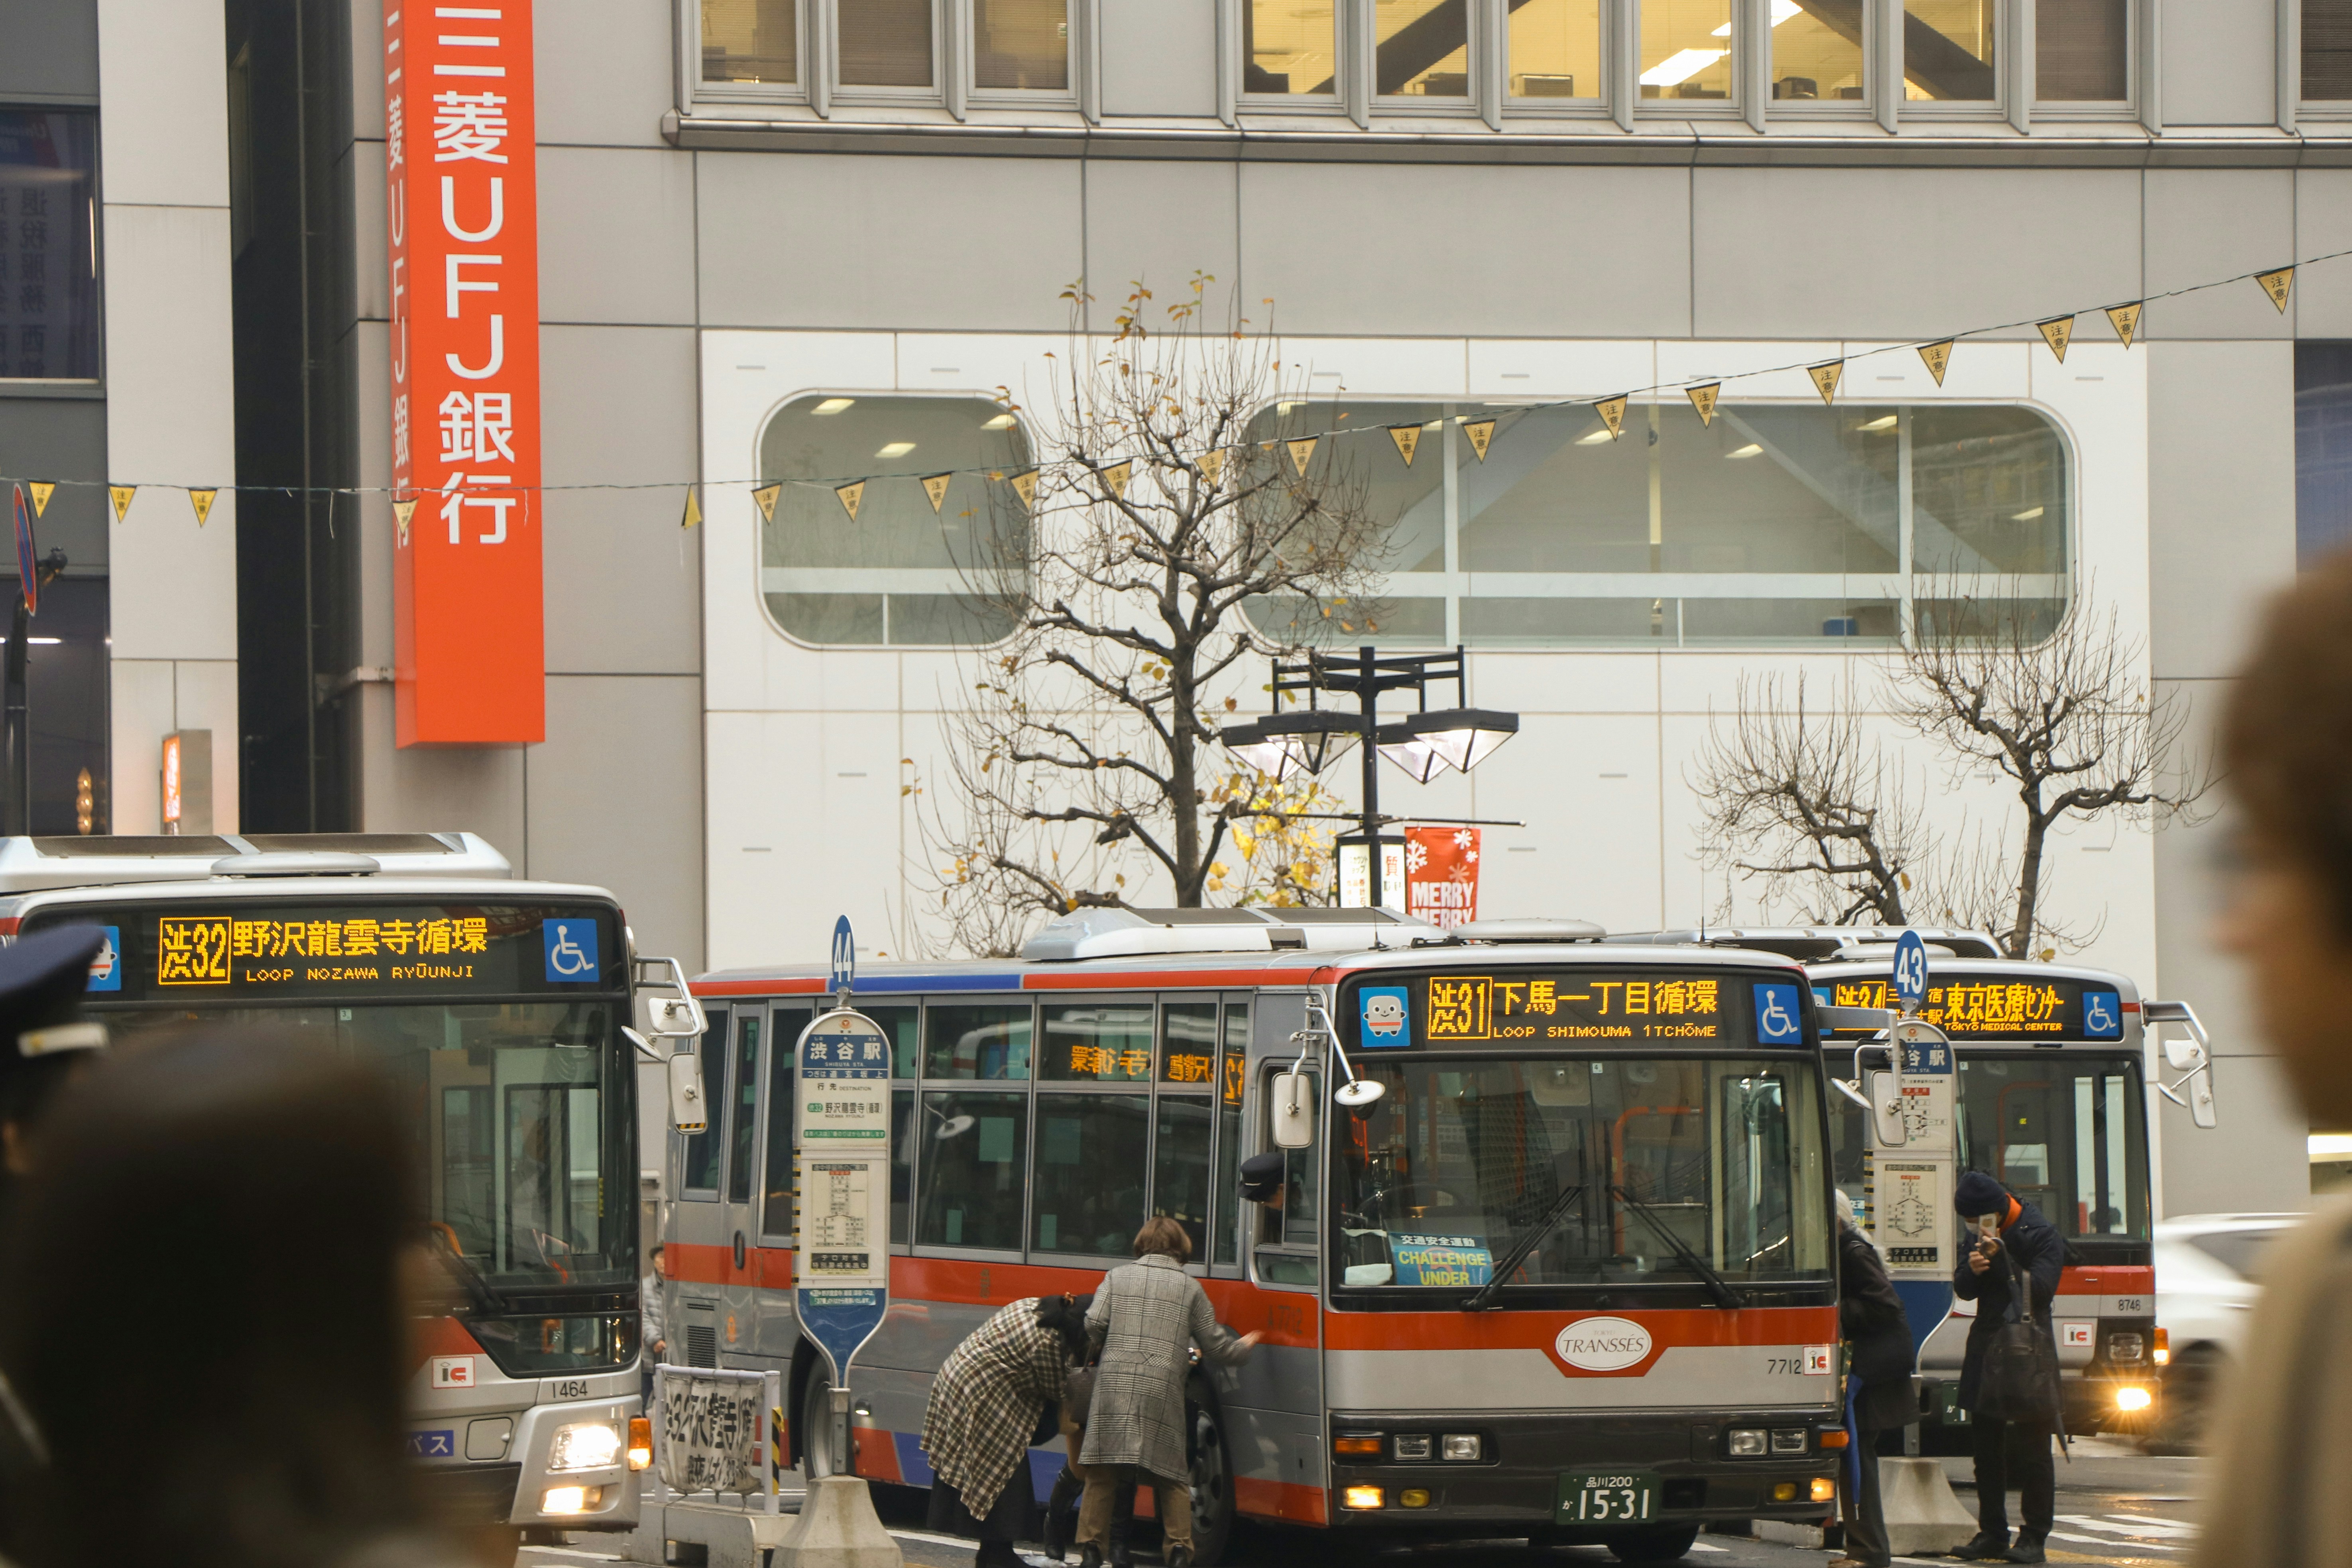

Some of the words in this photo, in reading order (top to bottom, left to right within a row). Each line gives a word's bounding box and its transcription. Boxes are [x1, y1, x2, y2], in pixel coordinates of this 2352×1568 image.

[433, 7, 516, 545] 三菱UFJ銀行
[2271, 276, 2286, 301] 注意
[2119, 311, 2133, 335] 注意
[2051, 325, 2065, 348] 注意
[1930, 348, 1944, 372] 注意
[1821, 370, 1834, 393] 注意
[1698, 391, 1711, 414] 注意
[1607, 404, 1619, 427] 注意
[1401, 431, 1412, 454] 注意
[1474, 428, 1486, 449] 注意
[1386, 856, 1398, 876] 質
[1411, 881, 1474, 908] MERRY
[163, 923, 226, 978] 渋32
[233, 918, 487, 957] 野沢龍雲寺循環
[834, 932, 852, 982] 44
[246, 969, 293, 981] LOOP
[307, 968, 378, 980] NOZAWA
[392, 963, 472, 978] RYŪUNJI
[1897, 947, 1924, 994] 43
[1432, 983, 1485, 1033] 渋31
[1494, 981, 1718, 1015] 下馬一丁目循環
[1945, 983, 2064, 1023] 東京医療センター
[1494, 1027, 1535, 1037] LOOP
[1548, 1026, 1632, 1037] SHIMOUMA
[1981, 1023, 2023, 1031] MEDICAL
[2025, 1023, 2063, 1031] CENTER
[810, 1042, 881, 1060] 渋谷駅
[1401, 1235, 1475, 1247] 交通安全運動
[1398, 1251, 1487, 1266] CHALLENGE
[1420, 1271, 1470, 1286] UNDER
[1563, 1334, 1644, 1354] TRANSSÉS
[1768, 1359, 1801, 1375] 7712
[552, 1381, 588, 1398] 1464
[1586, 1476, 1632, 1487] 品川200
[1579, 1489, 1649, 1520] 15-31
